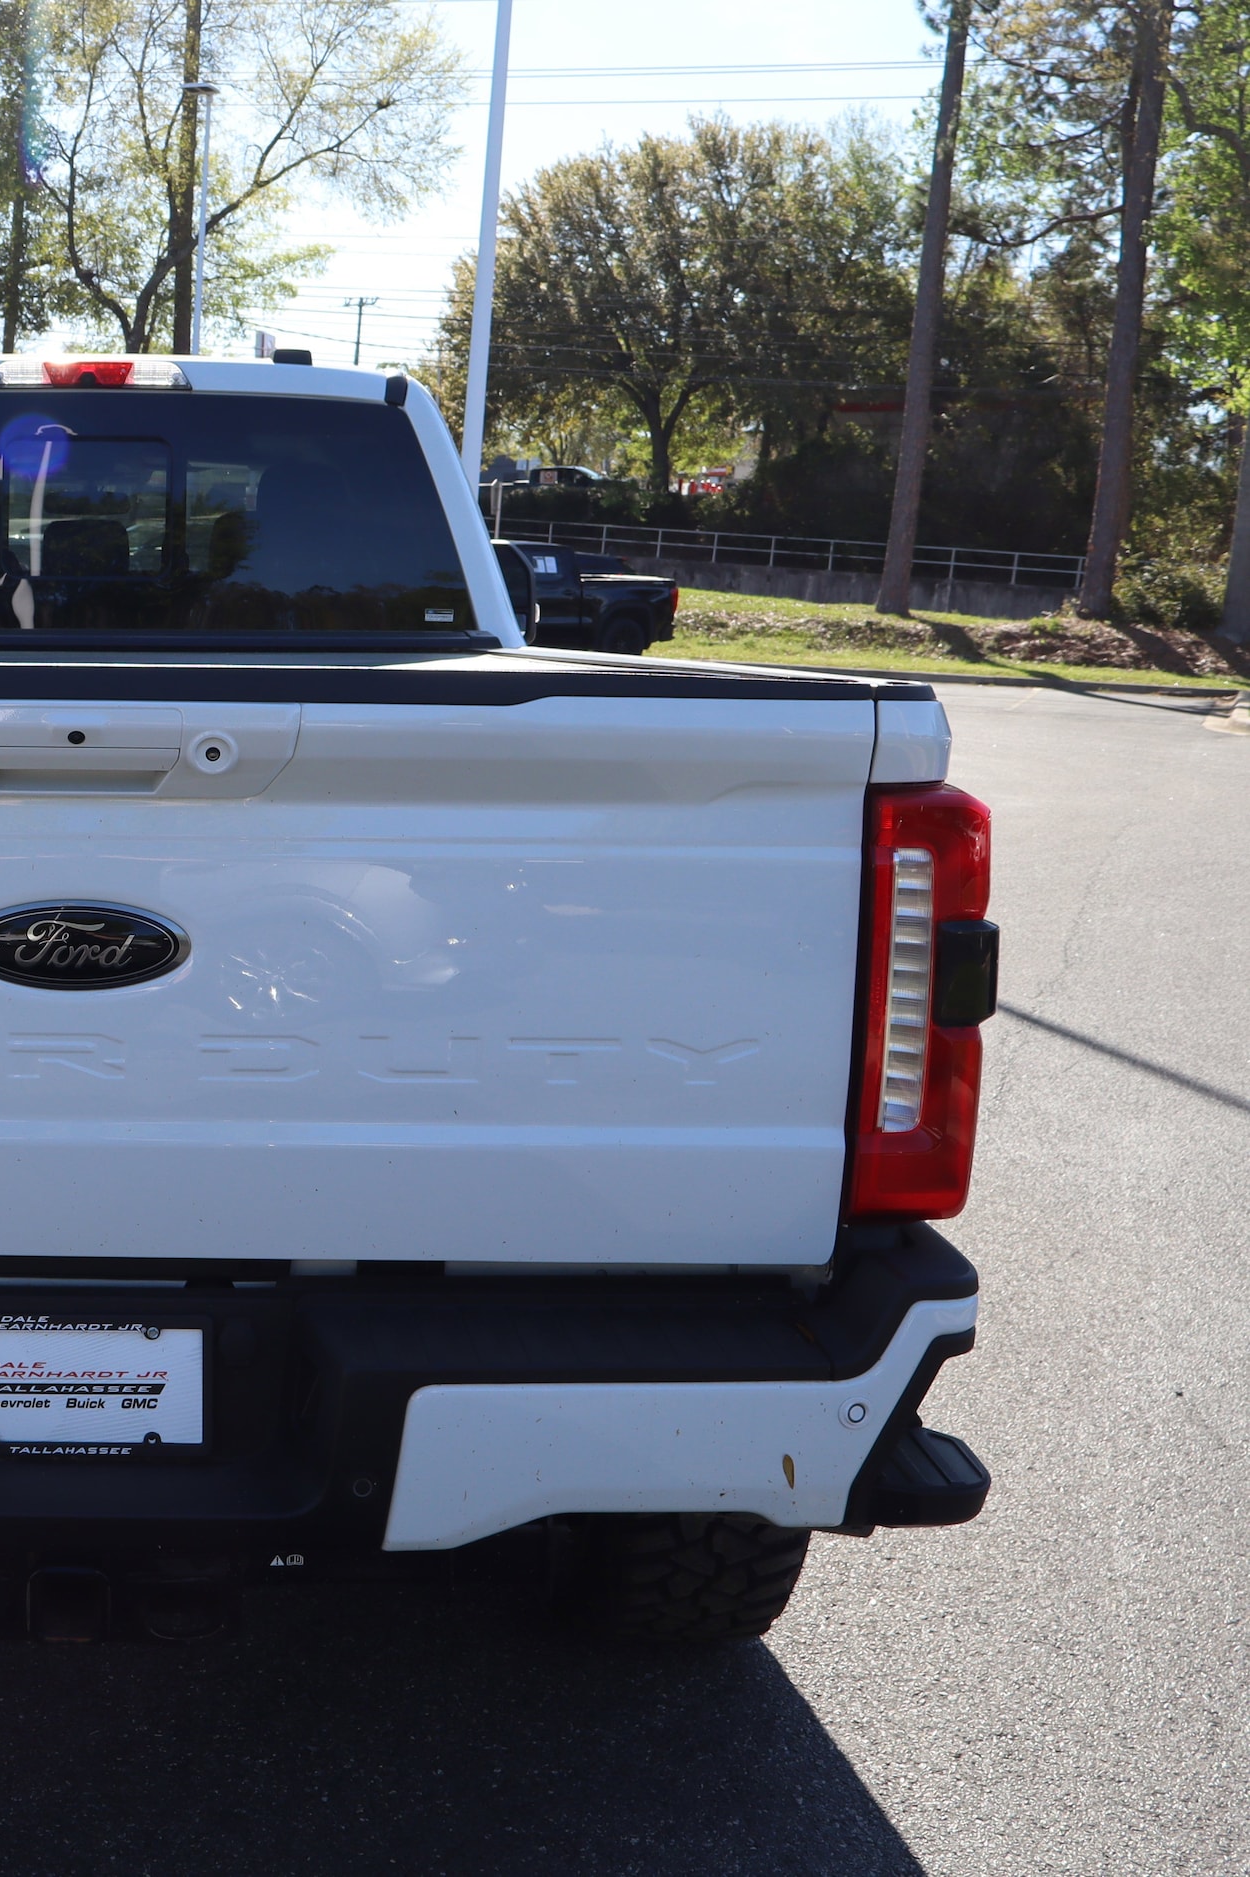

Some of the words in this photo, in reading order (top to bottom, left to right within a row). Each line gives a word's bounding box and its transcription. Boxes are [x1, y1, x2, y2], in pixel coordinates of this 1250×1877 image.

[14, 908, 136, 967] Ford
[197, 1031, 761, 1084] DUTY
[1, 1315, 50, 1323] DALE
[118, 1324, 143, 1332] JR
[66, 1398, 105, 1409] Buick
[121, 1399, 158, 1409] GMC
[9, 1446, 132, 1455] TALLAHASSEE
